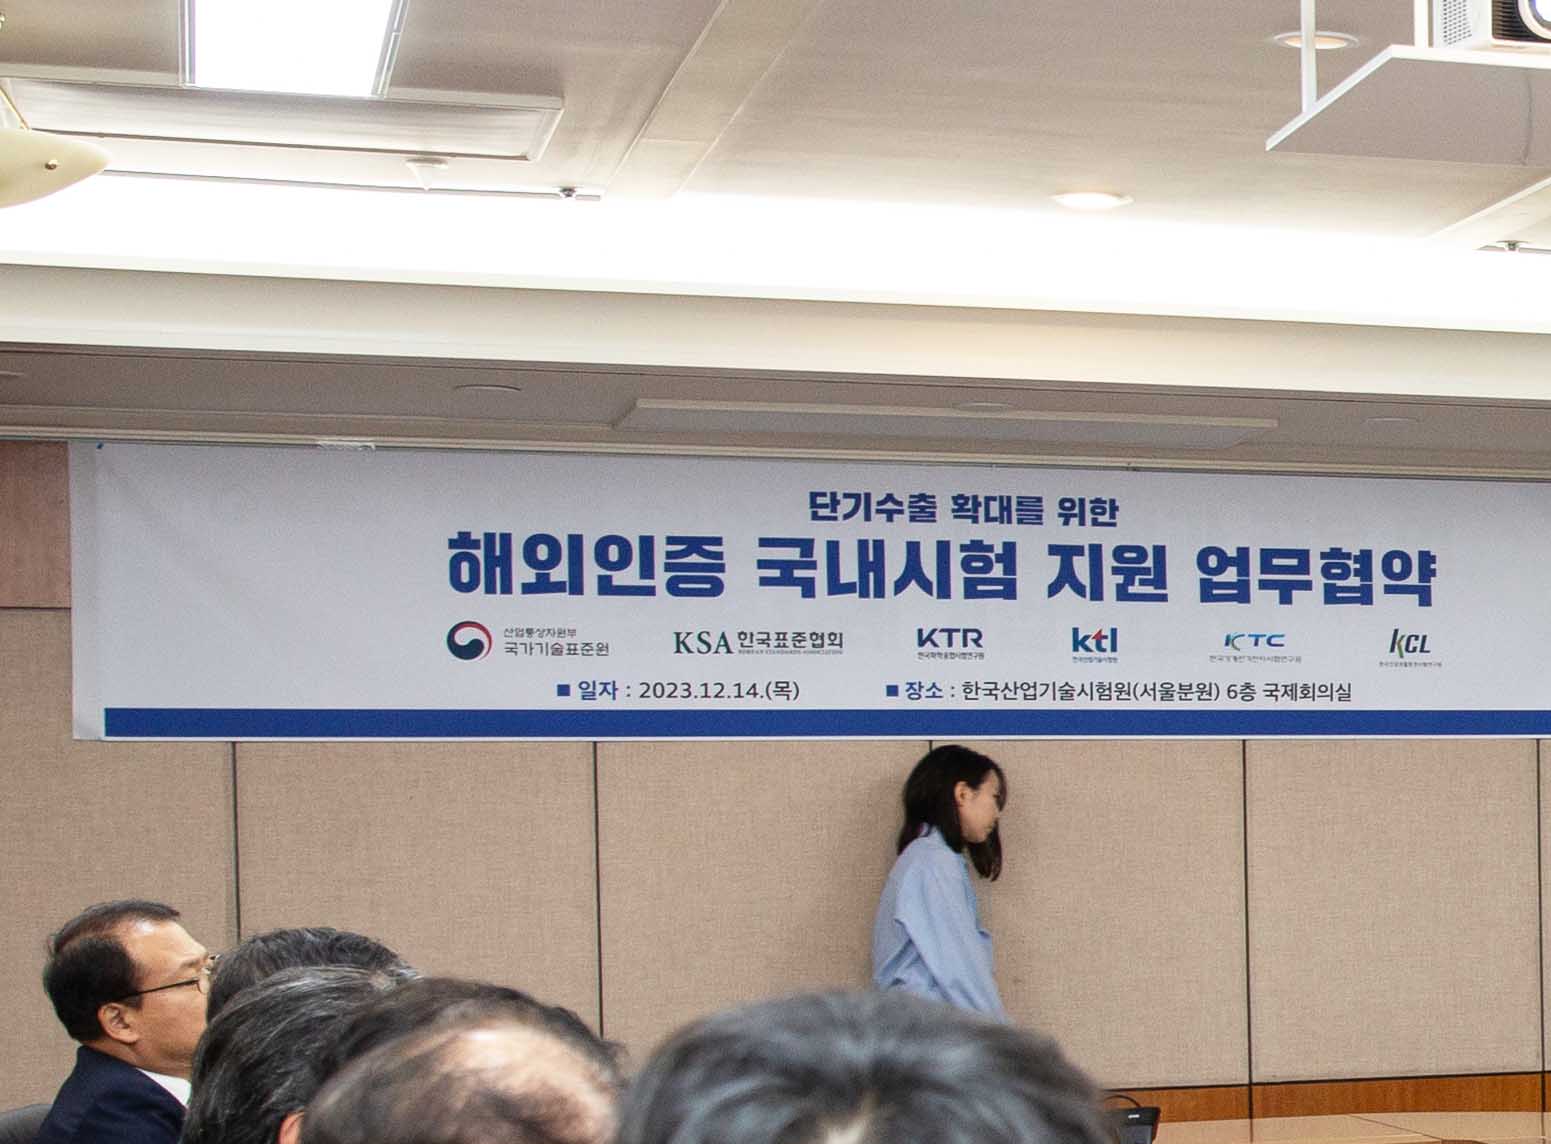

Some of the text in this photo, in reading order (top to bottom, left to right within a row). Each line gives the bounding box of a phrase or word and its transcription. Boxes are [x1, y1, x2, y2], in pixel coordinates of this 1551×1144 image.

[809, 491, 1119, 527] 단기수출 확대를 위한
[448, 531, 1436, 607] 해외인증 국내시험 지원 업무협약
[674, 631, 843, 654] KSA 한국표준협회
[917, 628, 982, 648] KTR
[1072, 627, 1117, 652] ktl
[1225, 634, 1285, 651] KTC
[504, 642, 609, 656] 국가기술표준원
[578, 680, 618, 700] 일자
[640, 681, 799, 700] 2023.12.14.(목)
[906, 681, 943, 700] 장소
[962, 681, 1220, 701] 한국산업기술시험원(서울분원)
[1227, 682, 1256, 702] 6층
[1263, 683, 1351, 702] 국제회의실
